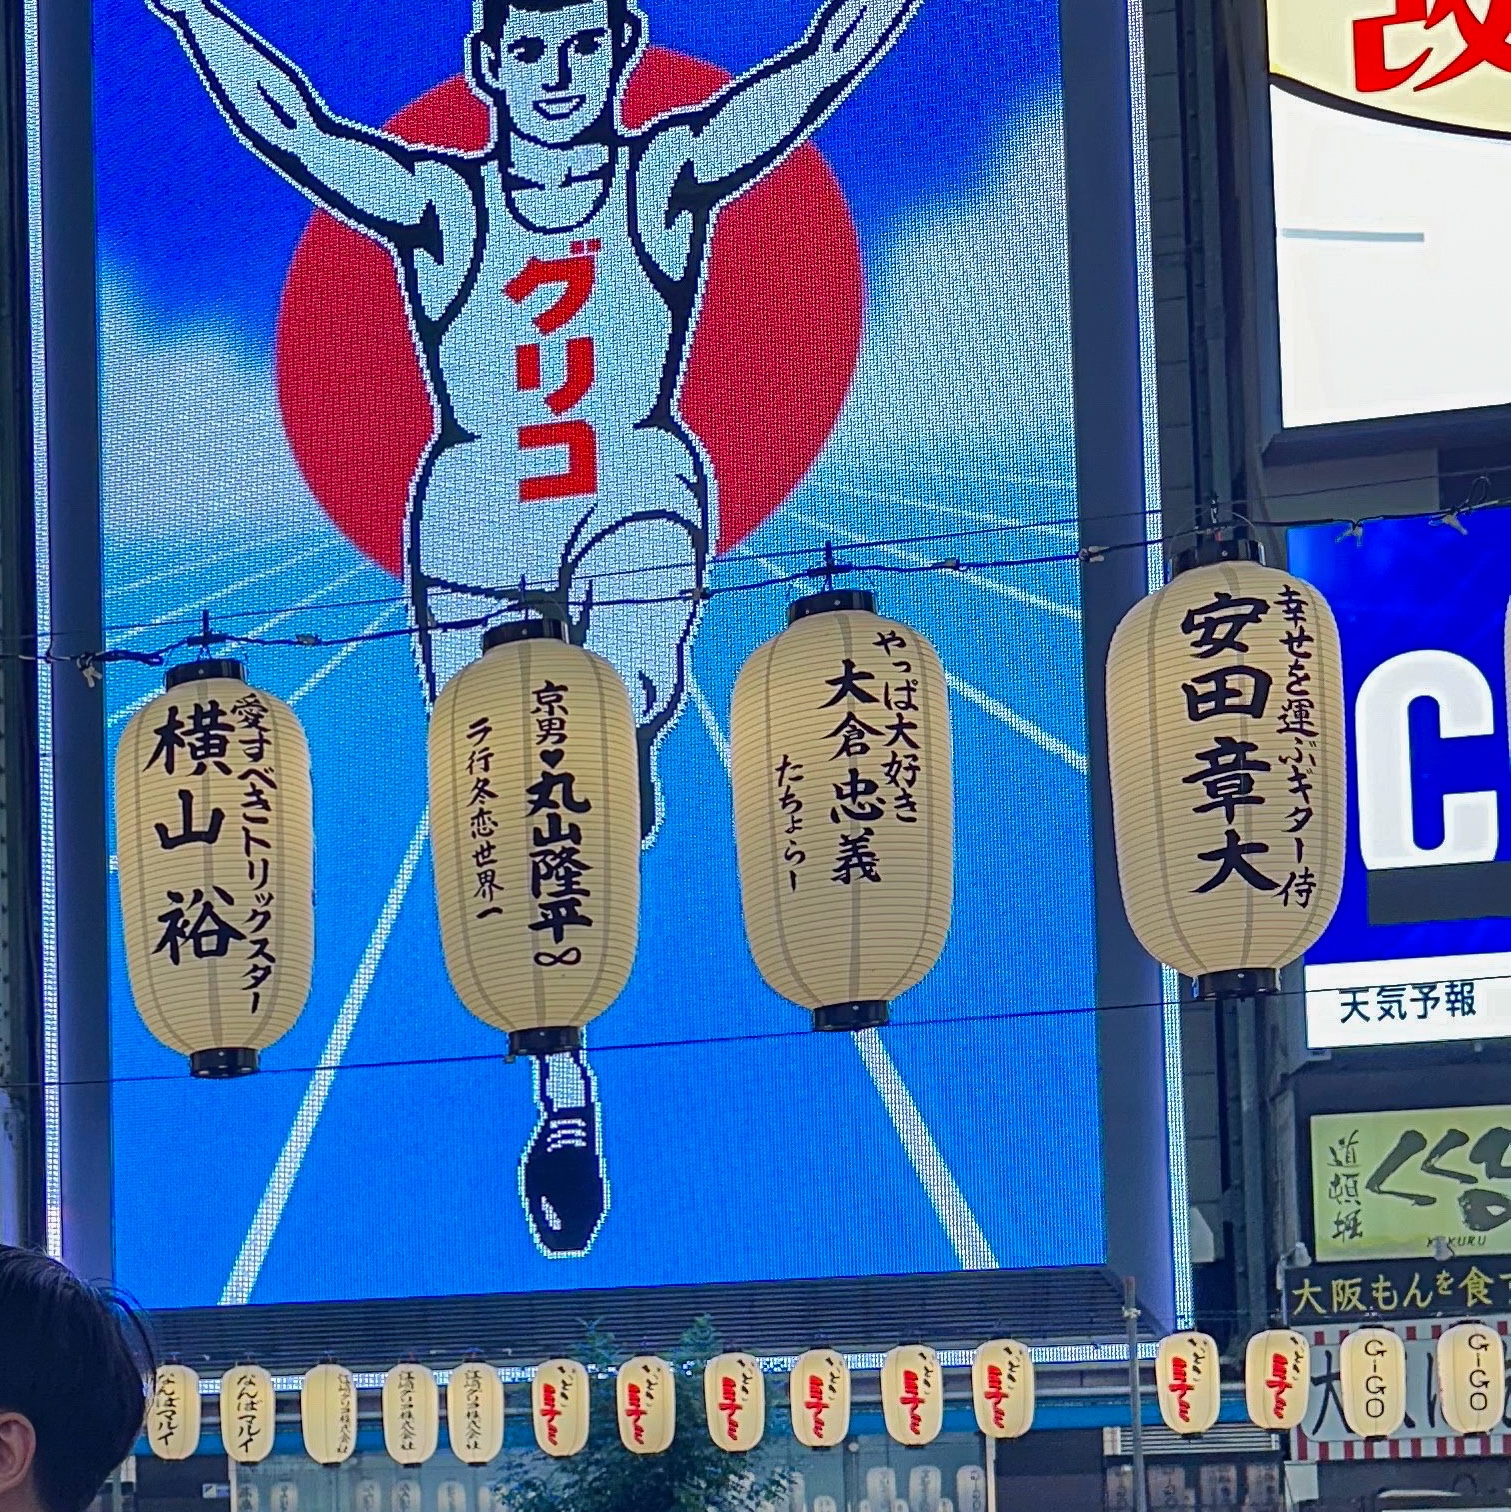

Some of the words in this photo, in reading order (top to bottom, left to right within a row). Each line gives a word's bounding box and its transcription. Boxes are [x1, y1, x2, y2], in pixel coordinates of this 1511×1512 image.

[504, 239, 601, 503] グリコ
[141, 699, 248, 968] 横山裕
[817, 658, 887, 885] 大倉忠義
[872, 629, 922, 825] やっぱ大好き
[1180, 591, 1282, 895] 安田章大
[1274, 584, 1320, 910] 幸せを運ぶギター侍
[1339, 981, 1477, 1024] 天気予報
[1292, 1265, 1511, 1317] 大阪もんを食
[236, 1372, 261, 1454] なんばマルイ
